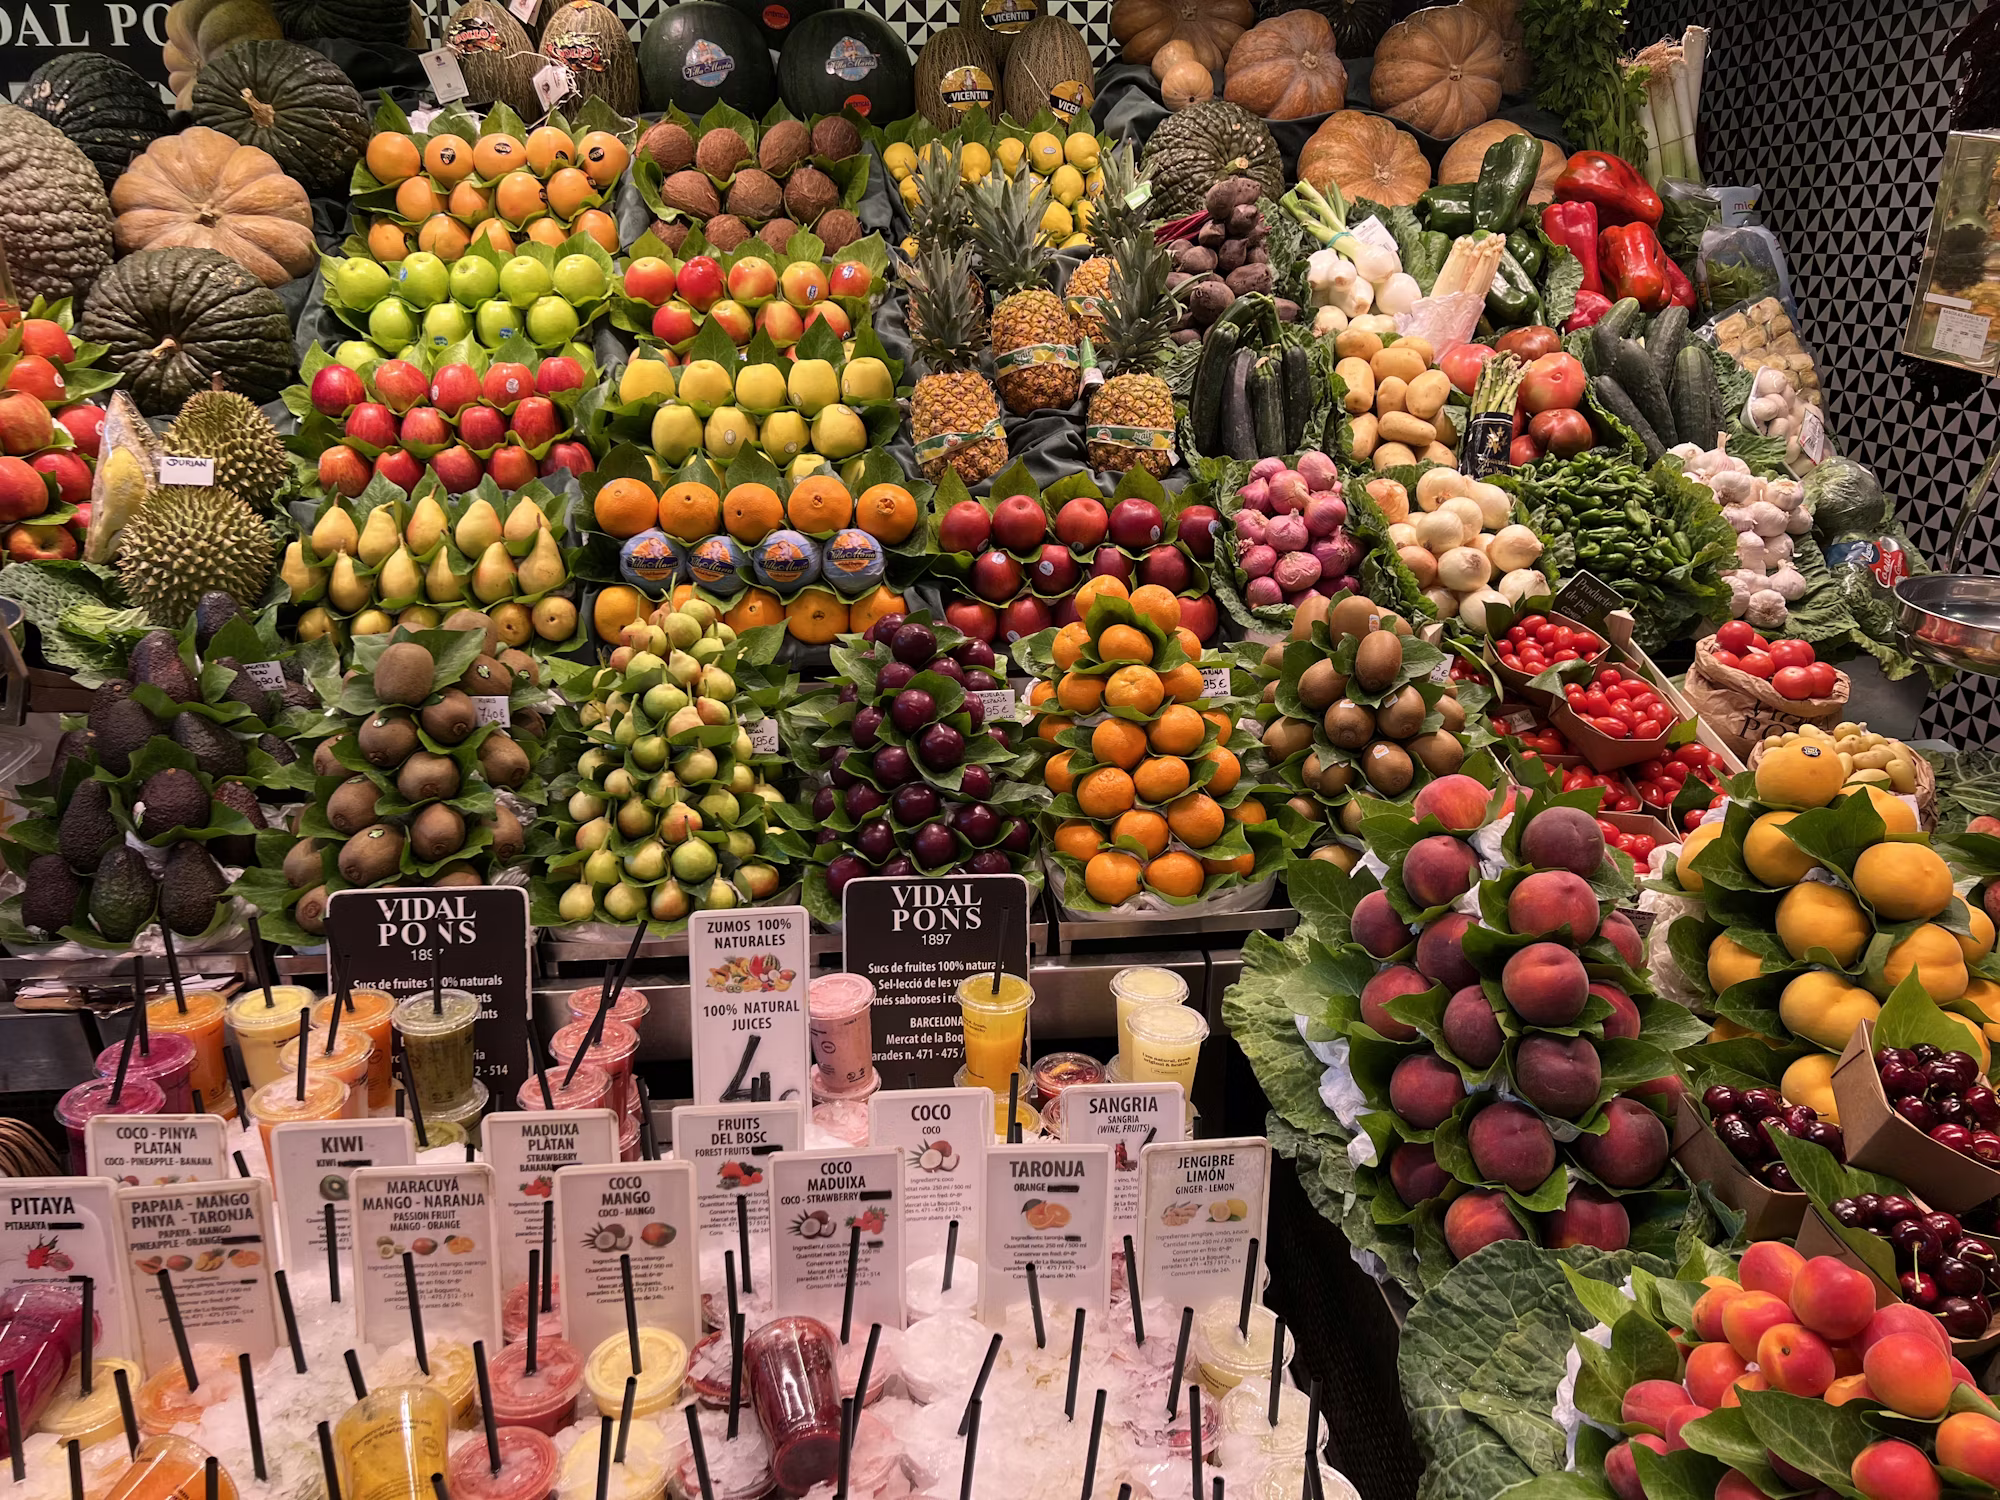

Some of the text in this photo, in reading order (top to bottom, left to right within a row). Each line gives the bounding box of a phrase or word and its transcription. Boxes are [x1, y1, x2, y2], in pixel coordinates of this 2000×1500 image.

[992, 11, 1029, 23] VICENTIN
[686, 65, 704, 78] Villa
[951, 91, 988, 101] VICENTIN
[167, 459, 207, 468] DURIAN
[1565, 590, 1579, 601] de
[1575, 578, 1613, 608] Producte
[1219, 679, 1227, 688] €
[1001, 705, 1009, 713] €
[891, 884, 982, 908] VIDAL
[376, 896, 476, 921] VIDAL
[707, 918, 792, 934] ZUMOS 100%
[892, 907, 982, 932] PONS
[378, 921, 476, 946] PONS
[921, 934, 952, 946] 1897
[715, 934, 785, 949] NATURALES
[411, 948, 444, 961] 189
[868, 960, 1005, 974] Sucs de fruites 100% naturas
[353, 975, 502, 989] Sucs de fruites 10% naturals
[924, 978, 936, 989] de
[938, 977, 951, 988] les
[874, 993, 946, 1006] més saboroses i
[704, 1000, 800, 1018] 100% NATURAL
[732, 1017, 772, 1031] JUICES
[910, 1016, 964, 1028] BARCELONA
[886, 1033, 919, 1044] Mercat
[921, 1032, 933, 1043] de
[935, 1032, 943, 1042] la
[872, 1050, 903, 1061] arades
[905, 1051, 914, 1060] n.
[917, 1049, 933, 1059] 471
[941, 1048, 959, 1058] 475
[1089, 1096, 1158, 1113] SANGRIA
[911, 1104, 951, 1121] COCO
[718, 1118, 760, 1131] FRUITS
[1108, 1115, 1140, 1124] SANGRIA
[117, 1127, 148, 1139] COCO
[160, 1127, 197, 1139] PINYA
[522, 1123, 579, 1137] MADUIXA
[922, 1126, 941, 1135] COCO
[1097, 1123, 1150, 1135] (WINE, FRUITS)
[321, 1136, 364, 1153] KIWI
[711, 1131, 767, 1145] DEL BOSC
[526, 1152, 578, 1163] STRAWBERRY
[695, 1147, 750, 1157] FOREST FRUITS
[131, 1158, 174, 1166] PINEAPPLE
[316, 1159, 336, 1167] KIWI
[519, 1163, 553, 1172] BANANA
[821, 1161, 852, 1175] COCO
[1177, 1154, 1235, 1169] JENGIBRE
[1010, 1160, 1085, 1178] TARONJA
[1187, 1167, 1225, 1183] LIMÓN
[387, 1176, 459, 1194] MARACUYÁ
[609, 1176, 642, 1190] COCO
[807, 1176, 866, 1191] MADUIXA
[1014, 1183, 1046, 1192] ORANGE
[1175, 1185, 1203, 1195] GINGER
[1209, 1183, 1235, 1193] LEMON
[132, 1198, 184, 1214] PAPAIA
[197, 1193, 249, 1208] MANGO
[363, 1196, 412, 1211] MANGO
[424, 1193, 485, 1209] NARANJA
[601, 1191, 650, 1206] MANGO
[781, 1196, 800, 1205] COCO
[807, 1192, 859, 1203] STRAWBERRY
[11, 1197, 75, 1215] PITAYA
[598, 1208, 619, 1217] COCO
[625, 1206, 655, 1215] MANGO
[132, 1214, 174, 1229] PINYA
[190, 1208, 254, 1224] TARONJA
[394, 1210, 456, 1221] PASSION FRUIT
[5, 1222, 46, 1231] PITAHAYA
[158, 1229, 190, 1239] PAPAYA
[198, 1226, 232, 1236] MANGO
[390, 1221, 421, 1232] MANGO
[428, 1220, 461, 1230] ORANGE
[131, 1240, 179, 1251] PINEAPPLE
[186, 1236, 222, 1247] ORANGE
